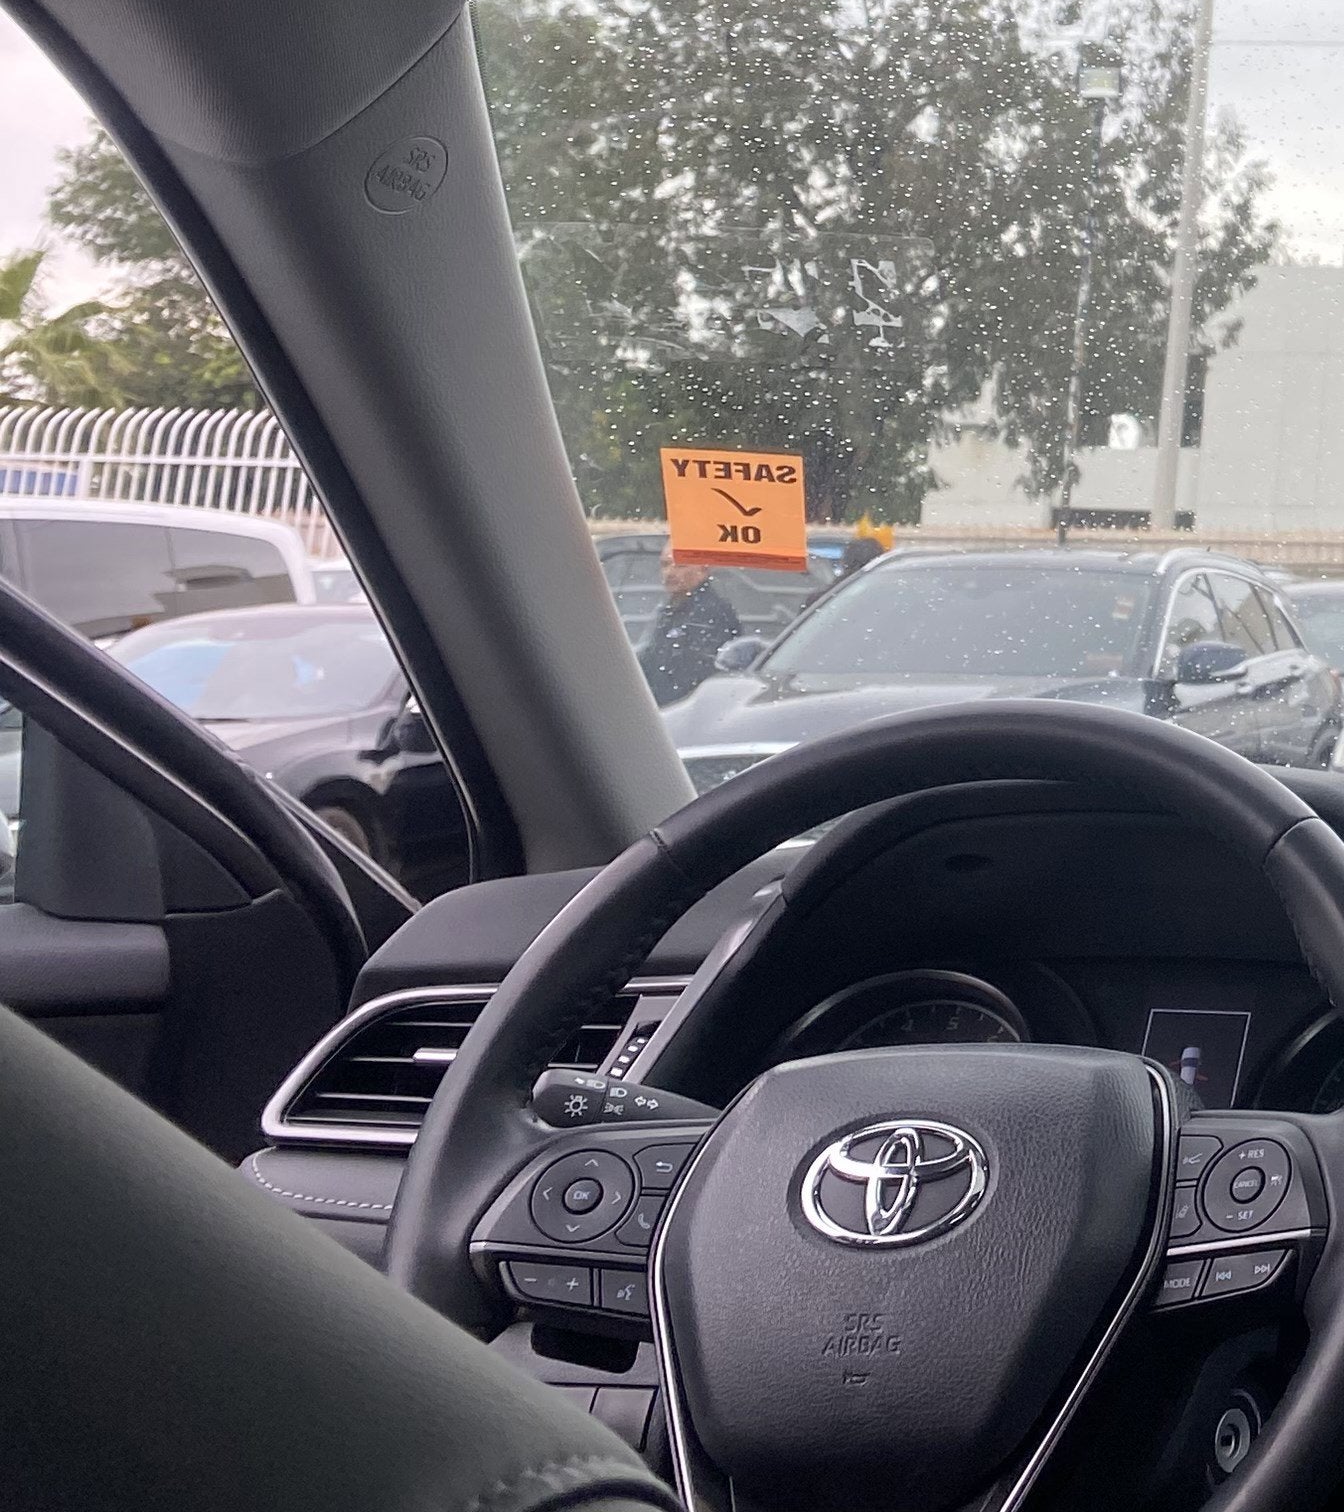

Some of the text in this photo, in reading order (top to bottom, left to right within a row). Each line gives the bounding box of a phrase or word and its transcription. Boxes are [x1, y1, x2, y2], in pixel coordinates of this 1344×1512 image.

[573, 1190, 592, 1201] OK
[1237, 1209, 1255, 1221] SET
[1163, 1277, 1191, 1289] MODE
[842, 1312, 887, 1333] SRS
[820, 1335, 903, 1357] AIRBAG
